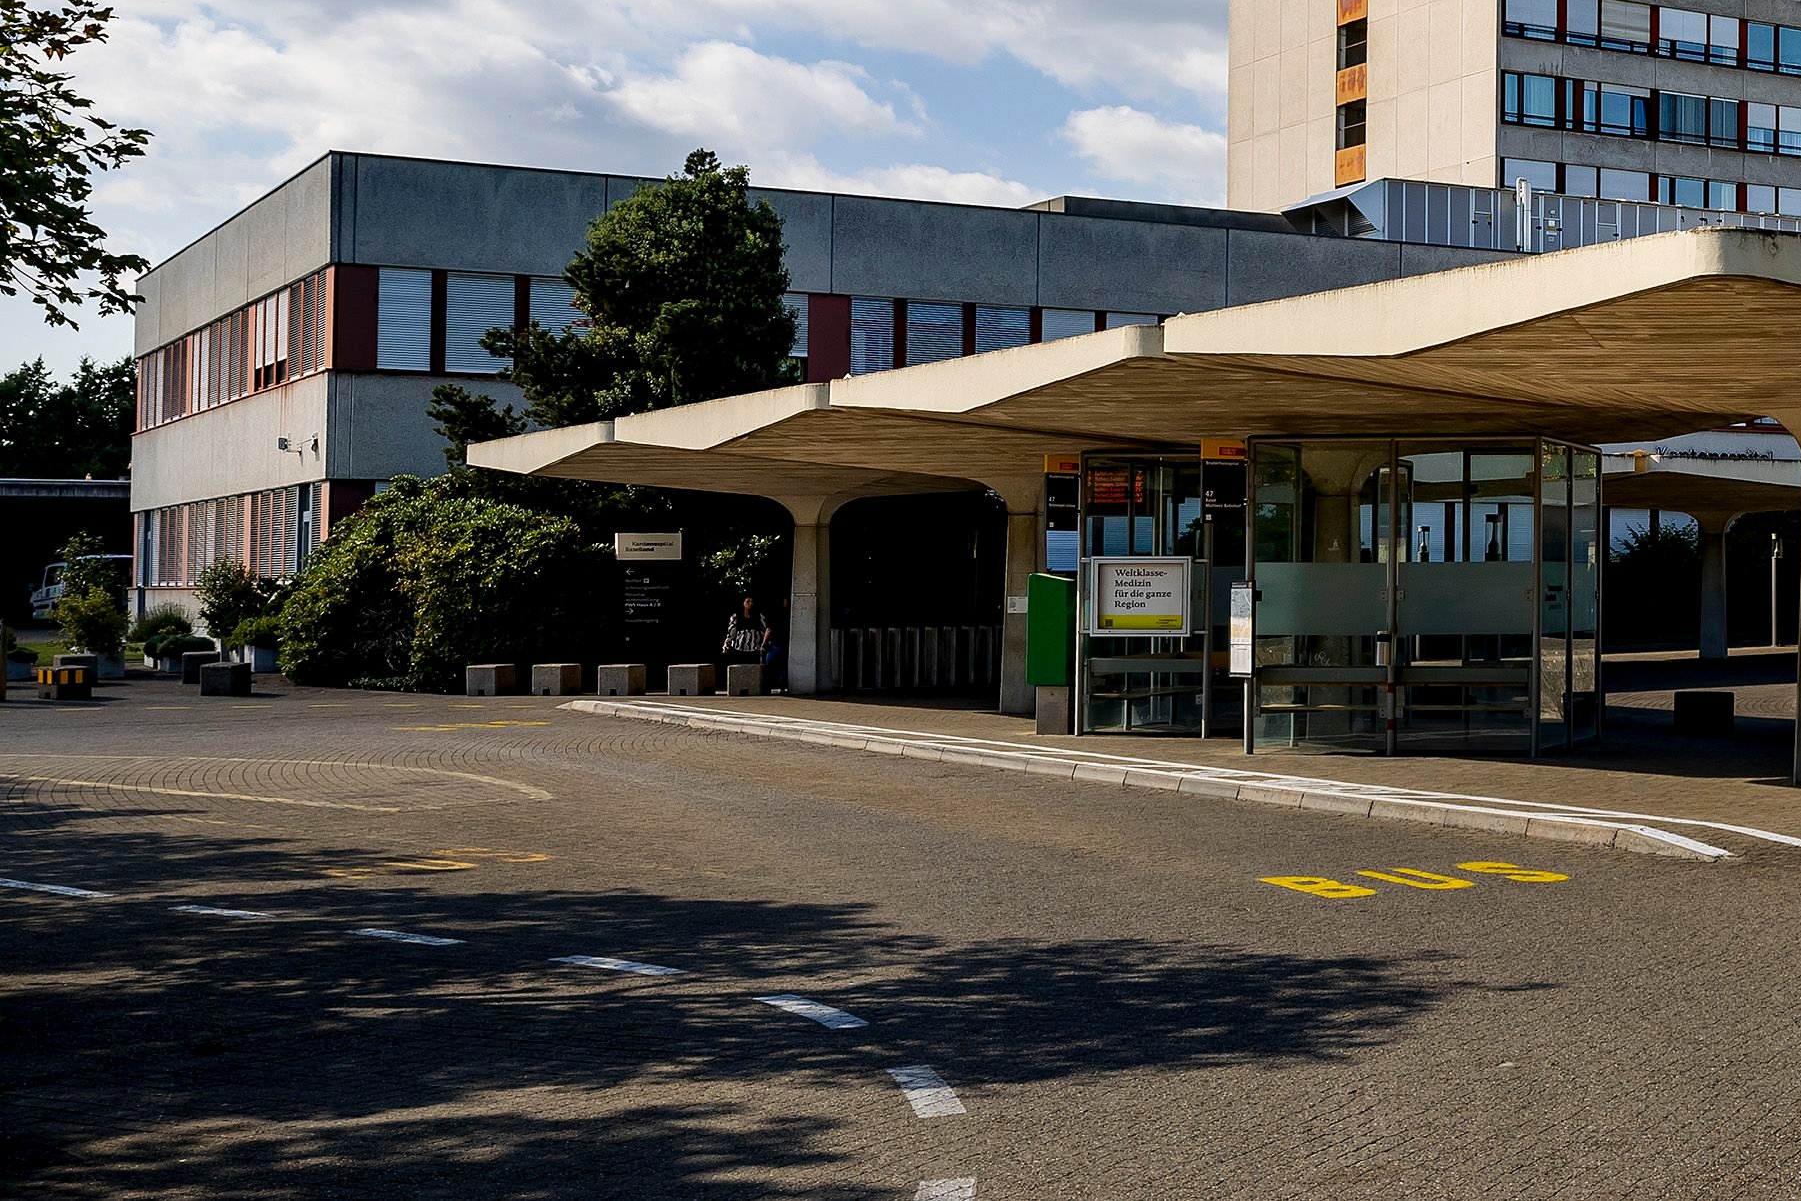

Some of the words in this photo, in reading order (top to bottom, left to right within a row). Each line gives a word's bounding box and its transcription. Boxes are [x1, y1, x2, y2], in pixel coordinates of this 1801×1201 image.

[1115, 569, 1168, 577] Weltklasse-
[1114, 590, 1130, 598] für
[1130, 590, 1144, 598] die
[1114, 600, 1146, 610] Region
[1256, 861, 1571, 899] BUS
